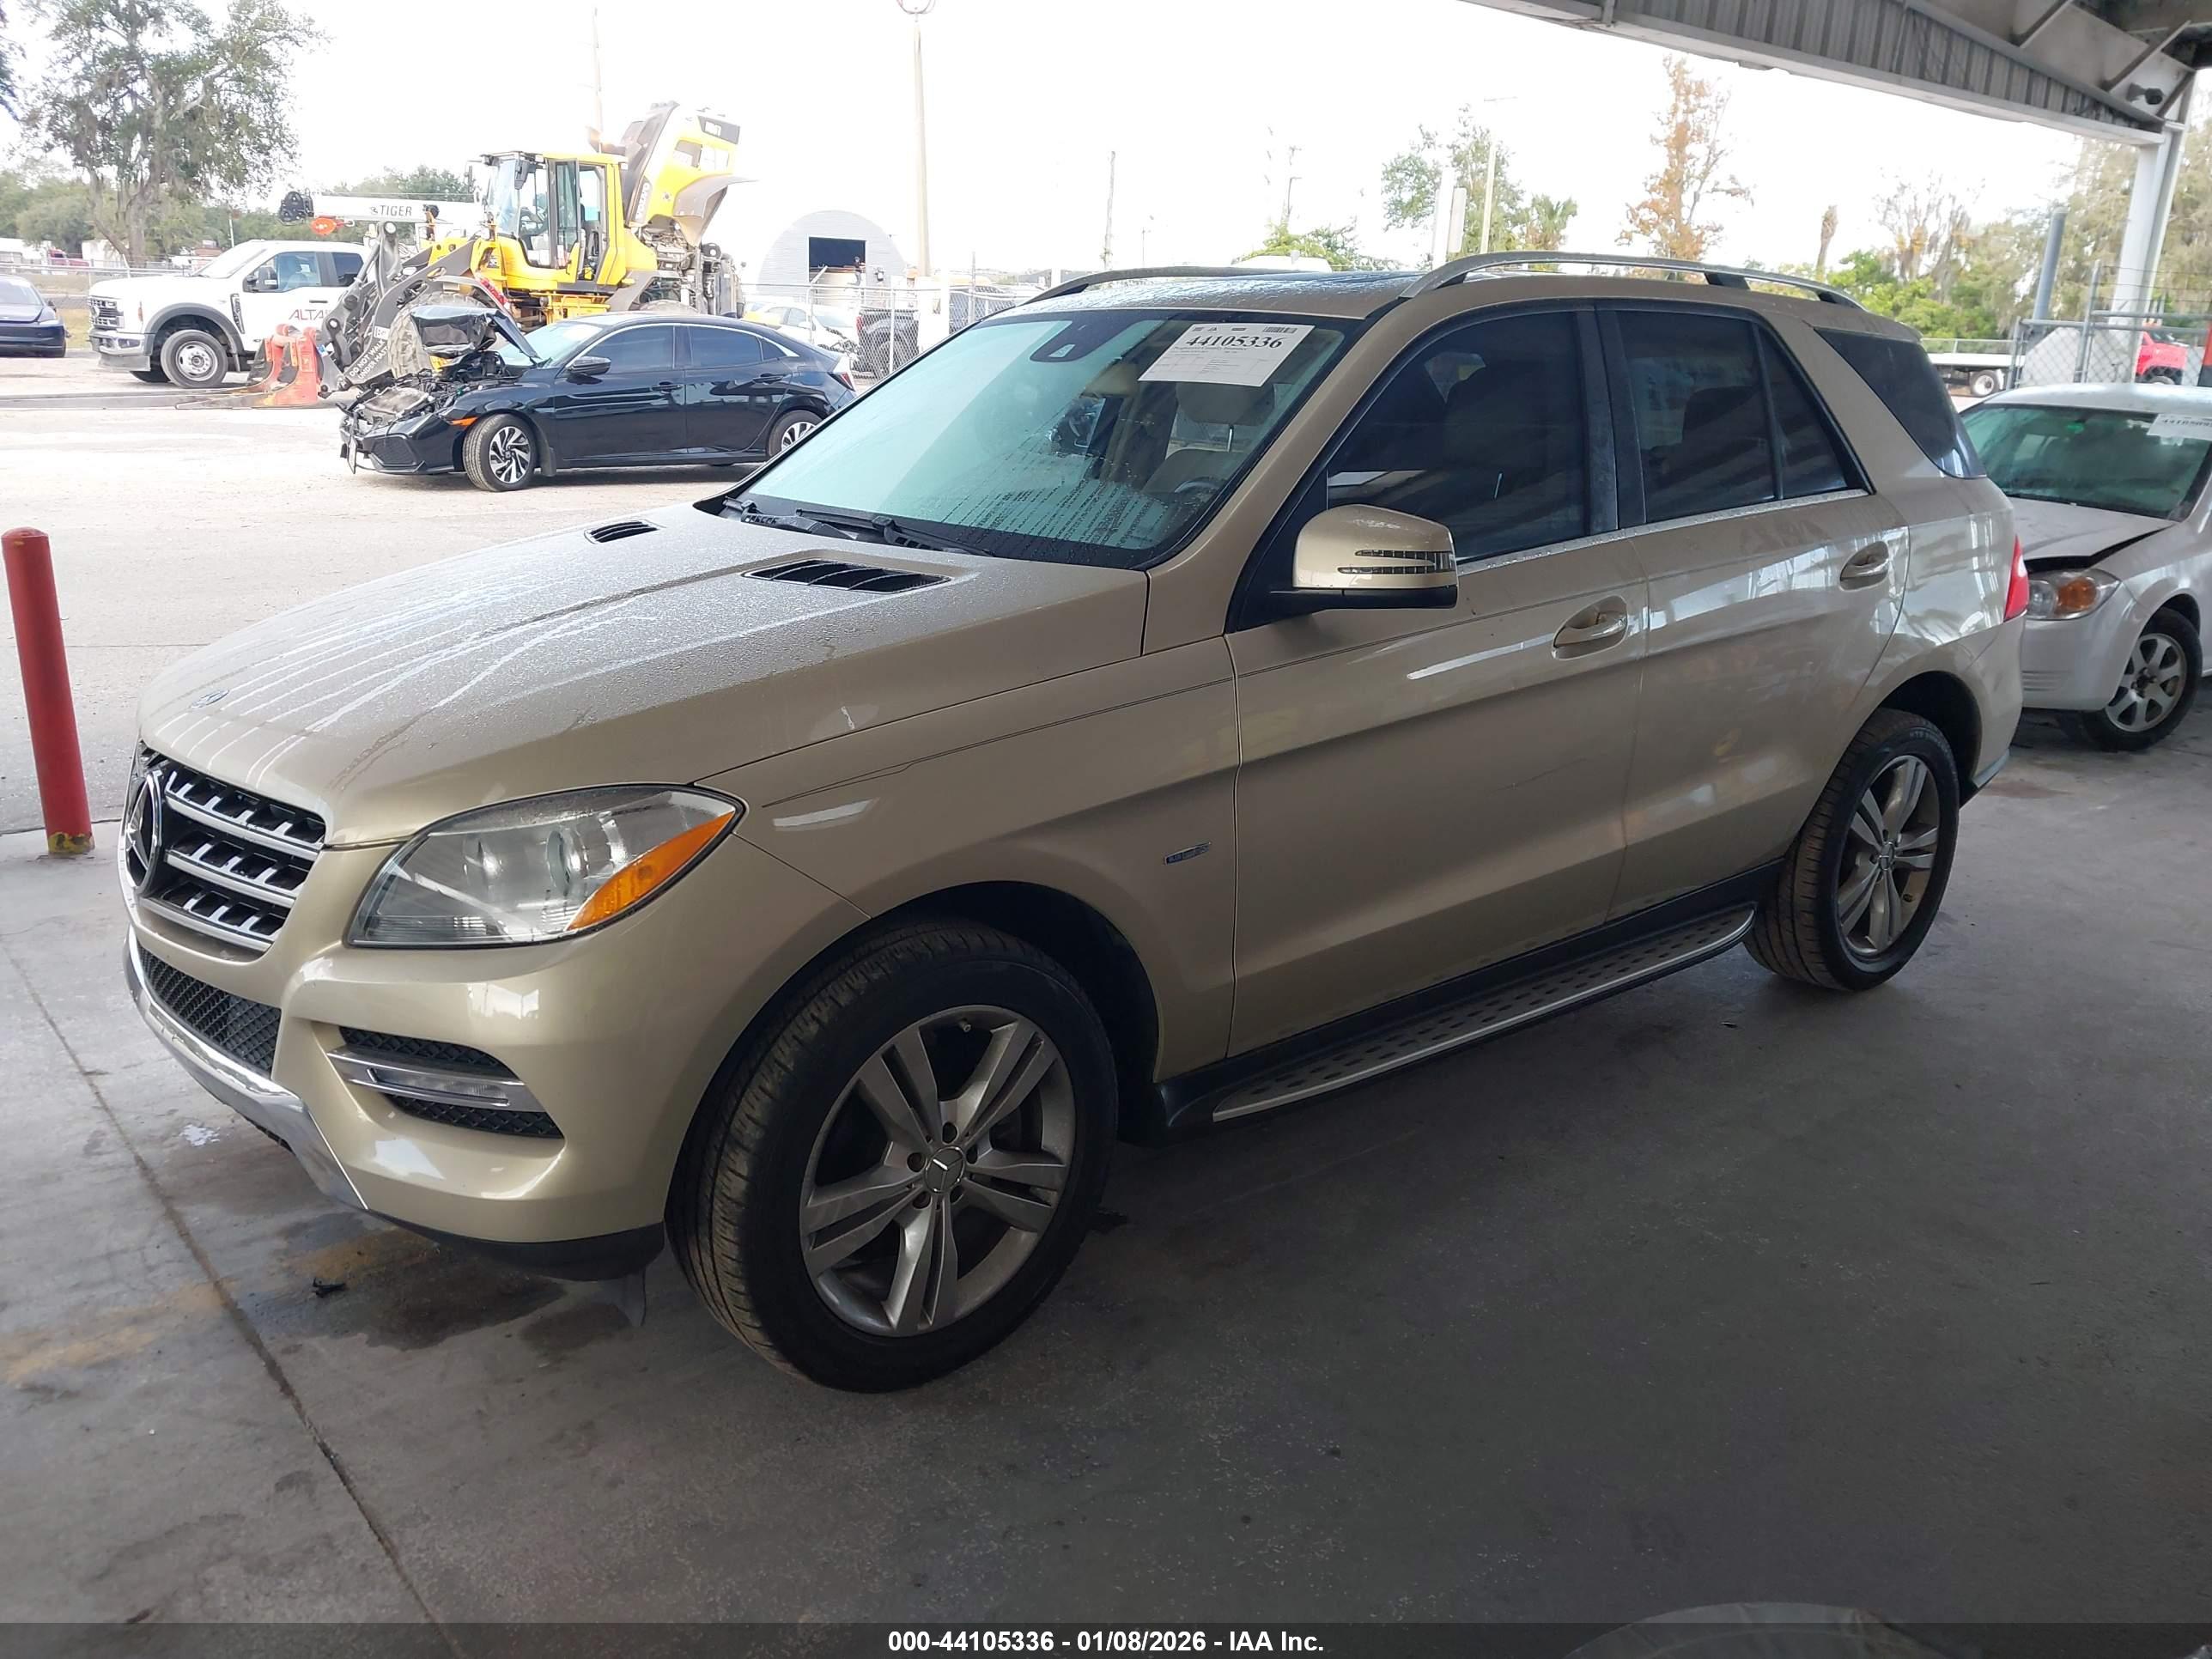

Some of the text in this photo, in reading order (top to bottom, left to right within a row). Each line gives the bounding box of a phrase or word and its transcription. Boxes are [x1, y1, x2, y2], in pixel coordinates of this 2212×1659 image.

[380, 204, 412, 216] TIGER
[289, 308, 325, 321] ALTA
[1186, 335, 1288, 349] 44105336
[349, 367, 360, 377] DO
[357, 354, 370, 370] NOT
[368, 338, 386, 356] WALK
[357, 361, 377, 379] UNDER
[374, 346, 388, 362] MAST
